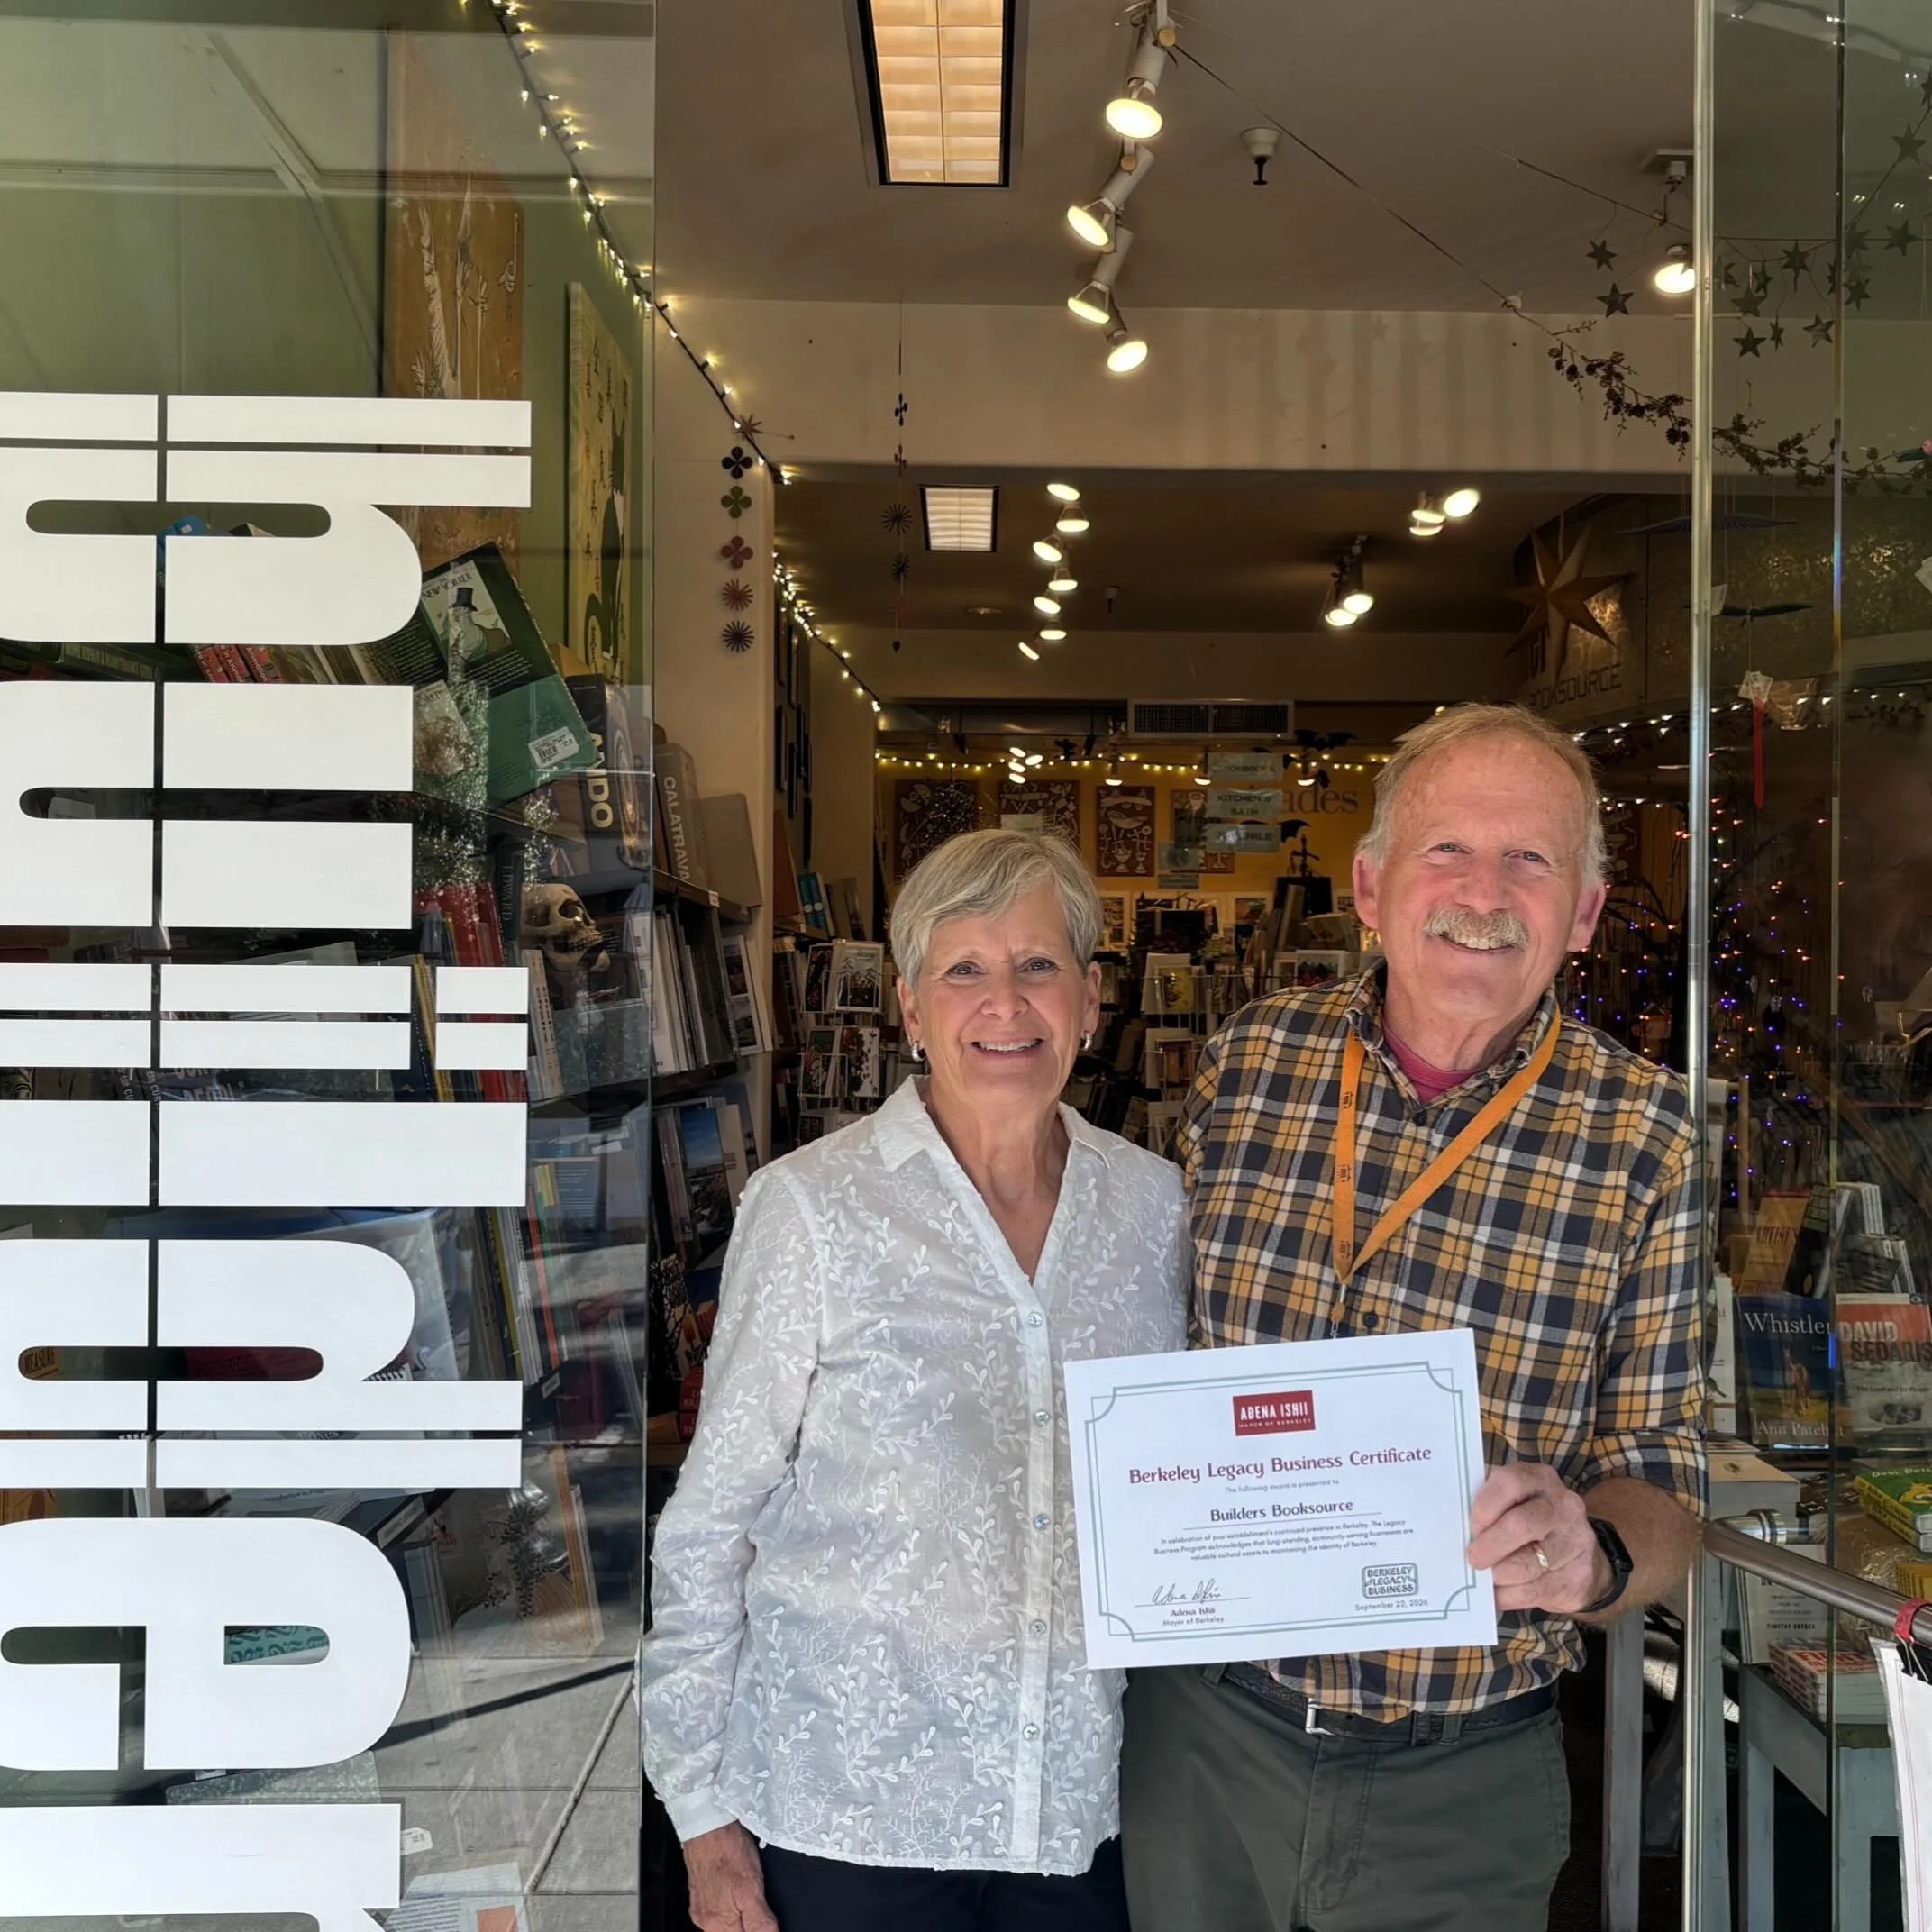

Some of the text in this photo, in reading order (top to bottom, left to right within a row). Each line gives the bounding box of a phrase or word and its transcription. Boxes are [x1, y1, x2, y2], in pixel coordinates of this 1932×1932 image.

[1217, 794, 1262, 803] KITCHEN
[1280, 785, 1359, 815] ades
[662, 776, 692, 882] CALATRAVA
[1217, 832, 1273, 843] JNILE
[502, 865, 515, 921] EDWARD
[1839, 1321, 1898, 1342] DAVID
[1240, 1401, 1308, 1421] ADENA ISHII
[1791, 1421, 1845, 1437] Patcht
[1129, 1444, 1432, 1485] Berkeley Legacy Business Certificate
[1298, 1480, 1331, 1489] presented
[1209, 1498, 1353, 1522] Builders Booksource
[1168, 1536, 1203, 1544] celebration
[1383, 1519, 1406, 1527] Legacy
[1366, 1566, 1413, 1577] BERKELEY
[1373, 1575, 1408, 1585] LEGACY
[1368, 1584, 1414, 1595] BUSINESS
[1171, 1607, 1216, 1617] Adena Ishii
[1354, 1600, 1394, 1611] September
[1195, 1617, 1225, 1625] Berkeley
